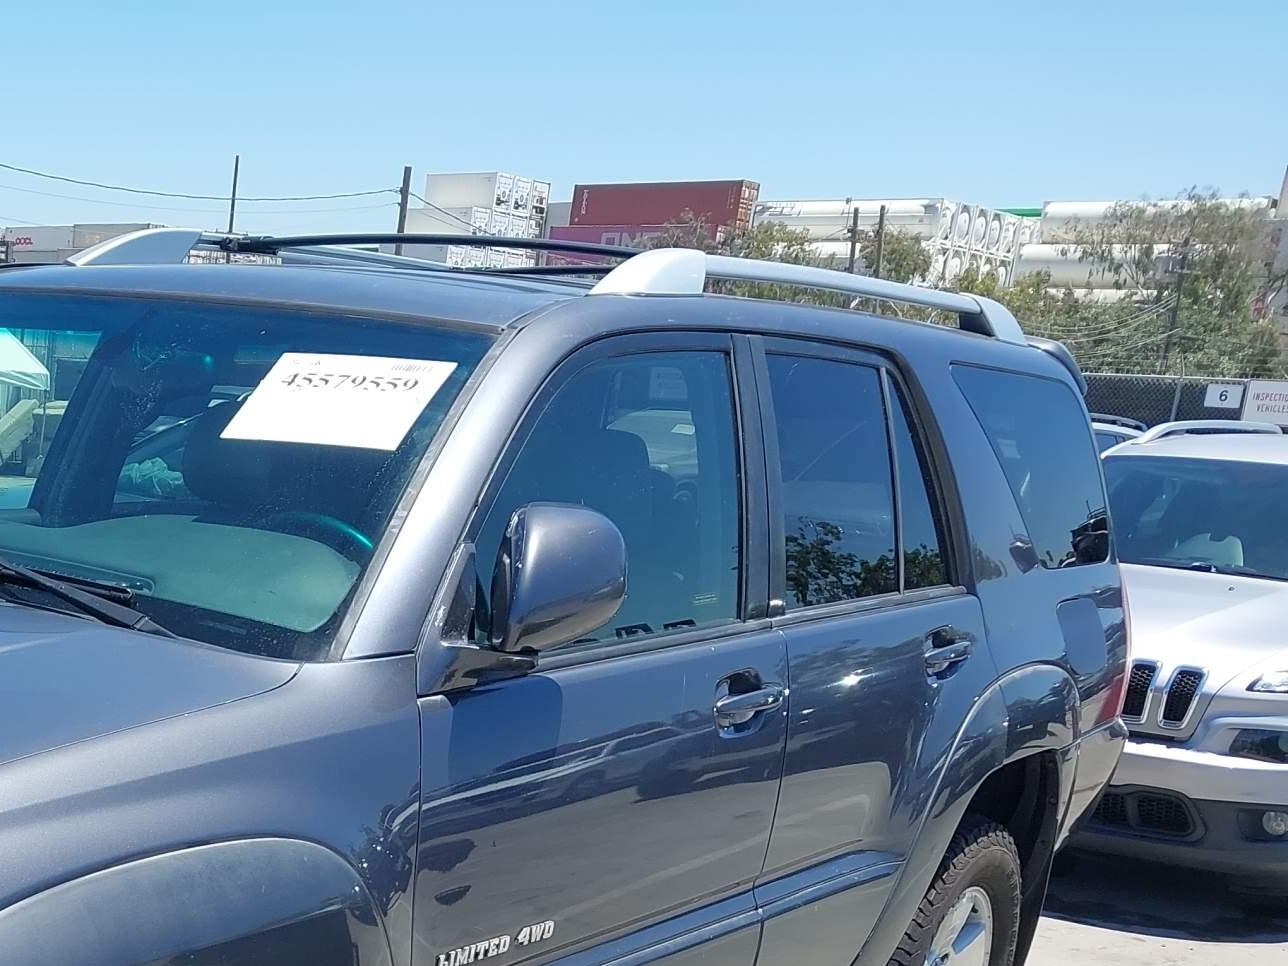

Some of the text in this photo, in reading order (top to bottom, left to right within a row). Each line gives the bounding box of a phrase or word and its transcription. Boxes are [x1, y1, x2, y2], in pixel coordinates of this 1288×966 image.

[281, 372, 420, 391] 45579559
[1219, 389, 1229, 402] 6
[516, 920, 555, 946] 4WD
